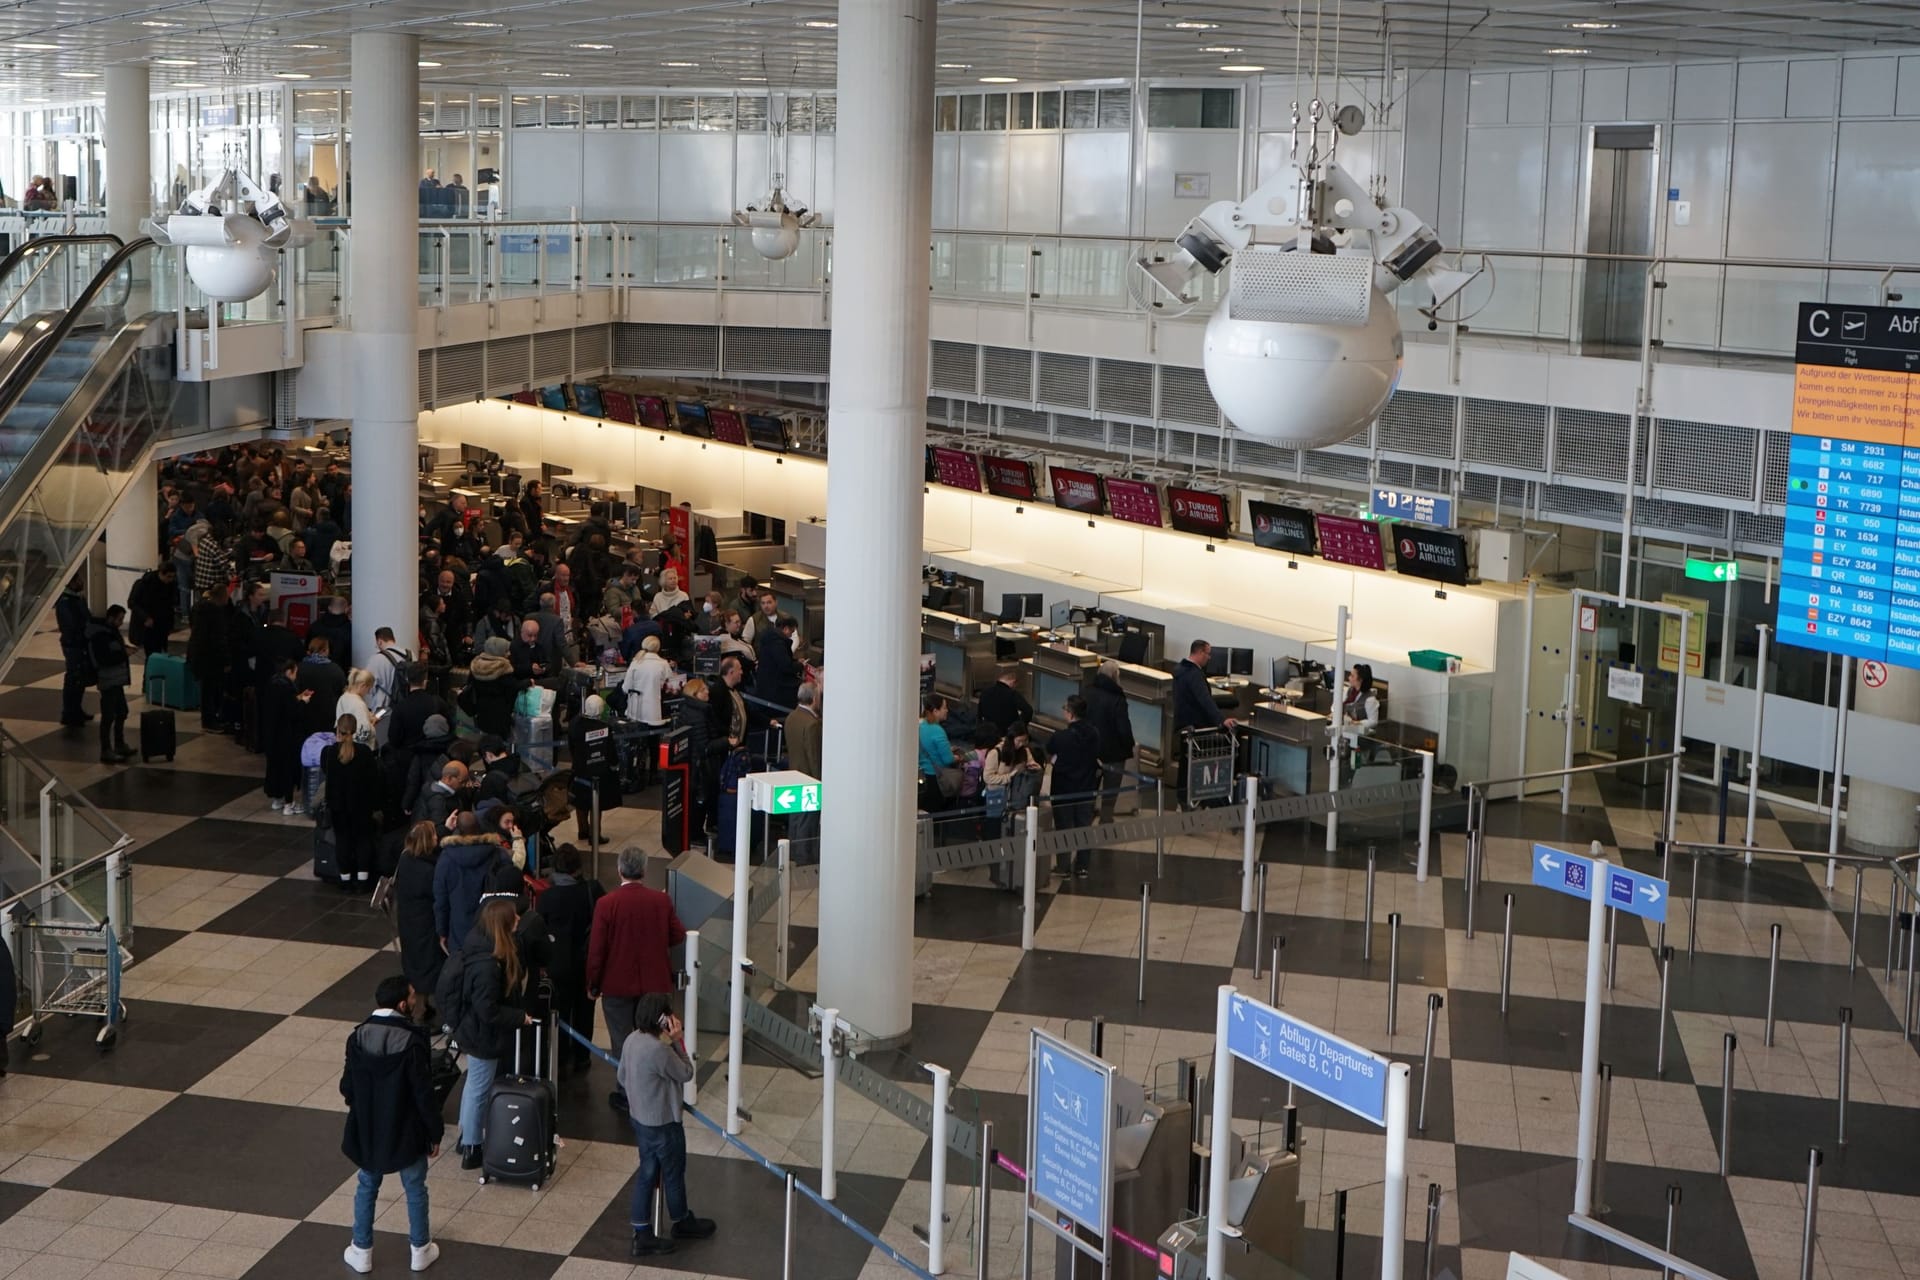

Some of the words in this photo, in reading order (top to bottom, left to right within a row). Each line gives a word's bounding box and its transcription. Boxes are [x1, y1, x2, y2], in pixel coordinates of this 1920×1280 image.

[1810, 310, 1830, 337] C
[1800, 368, 1836, 378] Aufgrund
[1854, 373, 1916, 385] Wettersituation
[1838, 386, 1857, 394] noch
[1860, 389, 1885, 397] immer
[1798, 396, 1878, 412] Unregelmäßigkeiten
[1797, 410, 1811, 418] Wir
[1812, 411, 1834, 420] bitten
[1841, 443, 1855, 452] SM
[1864, 446, 1885, 456] 2931
[1840, 458, 1852, 466] X3
[1862, 460, 1885, 470] 6682
[1068, 480, 1094, 491] TURKISH
[1838, 472, 1851, 480] AA
[1867, 475, 1884, 484] 717
[1901, 479, 1920, 489] Cha
[1069, 489, 1096, 500] AIRLINES
[1839, 486, 1850, 495] TK
[1188, 501, 1218, 513] TURKISH
[1388, 492, 1397, 508] D
[1837, 500, 1848, 509] TK
[1860, 502, 1881, 513] 7739
[1189, 510, 1219, 522] AIRLINES
[1270, 516, 1303, 530] TURKISH
[1836, 515, 1848, 524] EK
[1864, 518, 1880, 528] 050
[1272, 527, 1305, 539] AIRLINES
[1835, 529, 1847, 538] TK
[1857, 532, 1879, 542] 1634
[1418, 542, 1455, 556] TURKISH
[1834, 543, 1846, 551] EY
[1862, 547, 1878, 557] 006
[1896, 552, 1913, 562] Abu
[1419, 552, 1456, 567] AIRLINES
[1833, 557, 1851, 567] EZY
[1855, 560, 1876, 571] 3264
[1832, 571, 1845, 581] QR
[1893, 581, 1917, 592] Doha
[1830, 585, 1842, 595] BA
[1858, 590, 1874, 600] 955
[1829, 599, 1840, 608] TK
[1828, 613, 1846, 624] EZY
[1850, 618, 1872, 629] 8642
[1827, 627, 1839, 637] EK
[1854, 632, 1871, 643] 052
[1888, 639, 1914, 651] Dubai
[1280, 1024, 1310, 1052] Abflug
[1312, 1038, 1318, 1052] /
[1320, 1041, 1374, 1078] Departures
[1280, 1040, 1307, 1065] Gates
[1309, 1054, 1318, 1072] B,
[1322, 1060, 1331, 1078] C,
[1335, 1066, 1342, 1081] D
